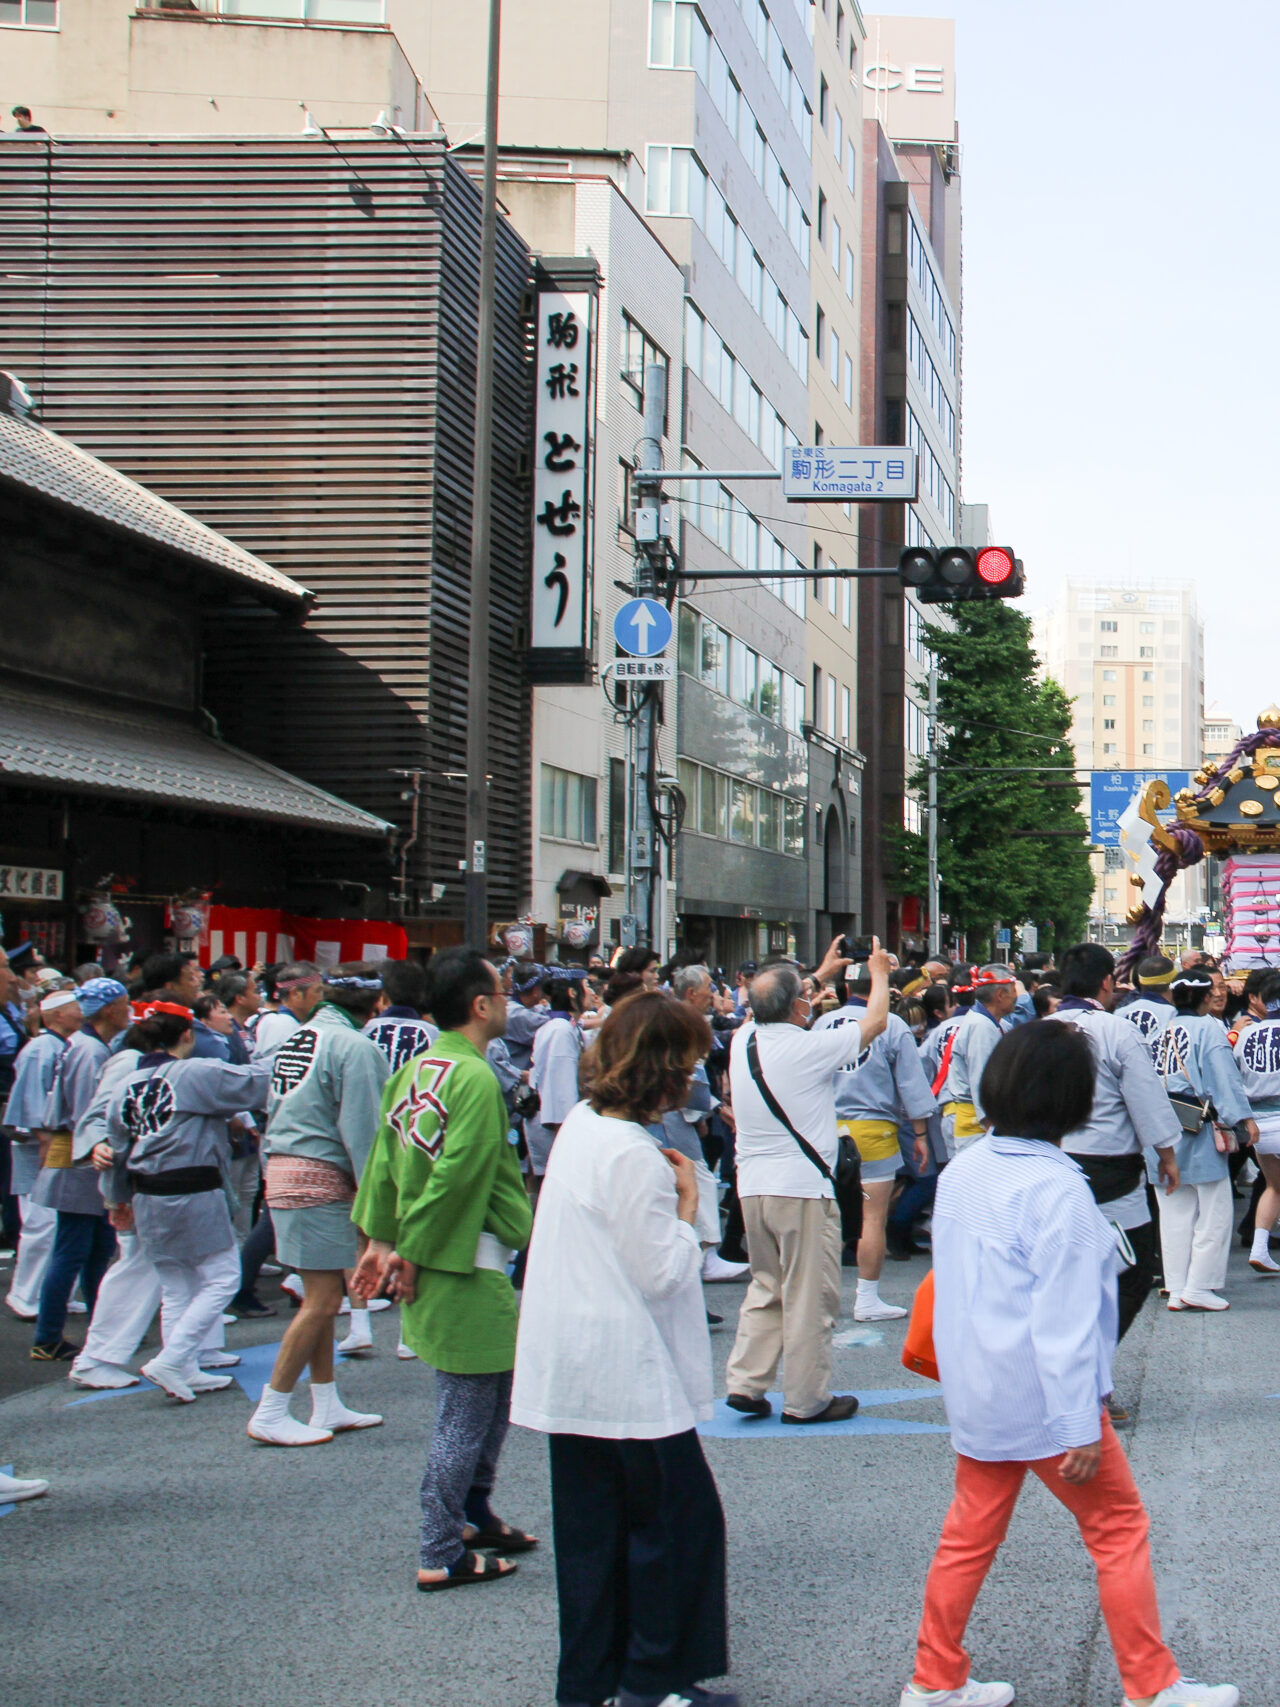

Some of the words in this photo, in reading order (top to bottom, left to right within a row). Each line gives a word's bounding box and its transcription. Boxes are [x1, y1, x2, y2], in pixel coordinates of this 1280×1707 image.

[792, 448, 825, 458] 台東区
[537, 311, 581, 628] 駒形どぜう
[791, 459, 905, 480] 駒形二丁目
[813, 481, 872, 494] Komagata
[876, 481, 884, 492] 2
[616, 663, 671, 676] 自転車を除く
[1095, 808, 1120, 821] 上野
